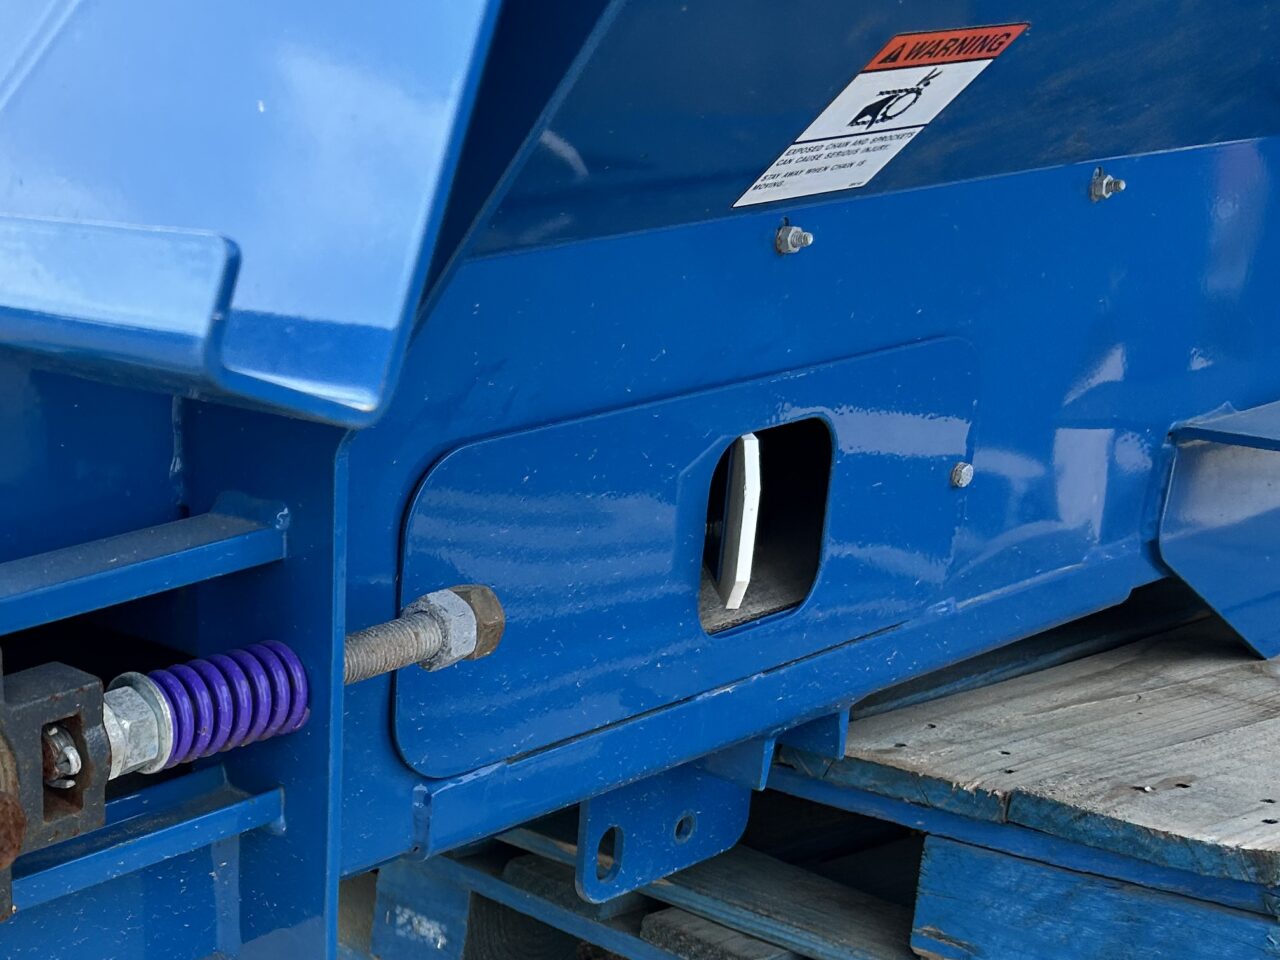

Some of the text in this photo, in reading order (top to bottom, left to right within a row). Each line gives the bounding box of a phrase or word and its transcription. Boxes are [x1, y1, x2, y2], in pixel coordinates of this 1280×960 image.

[904, 32, 1011, 61] WARNING
[785, 144, 824, 156] EXPOSED
[775, 157, 794, 166] CAN
[795, 153, 824, 163] CAUSE
[761, 172, 781, 182] STAY
[783, 169, 804, 178] AWAY
[805, 165, 829, 174] WHEN
